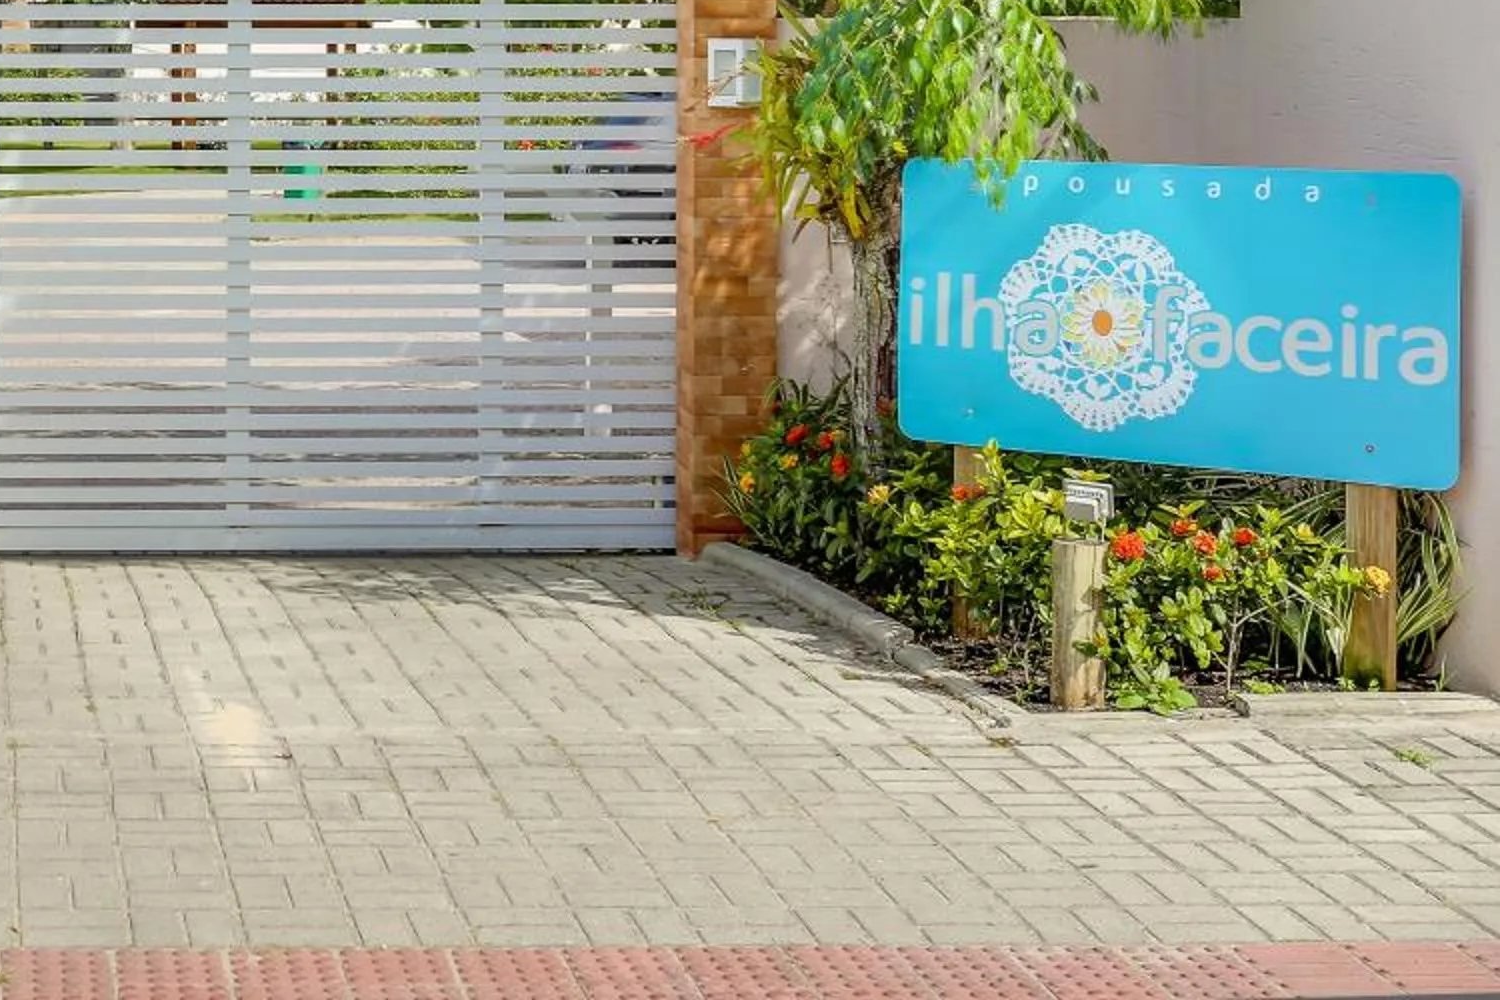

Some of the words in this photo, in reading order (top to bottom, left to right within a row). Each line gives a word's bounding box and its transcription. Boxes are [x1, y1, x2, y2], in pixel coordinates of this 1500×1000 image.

[1023, 174, 1320, 202] pousada
[909, 272, 1059, 356] ilha
[1149, 285, 1448, 385] faceira
